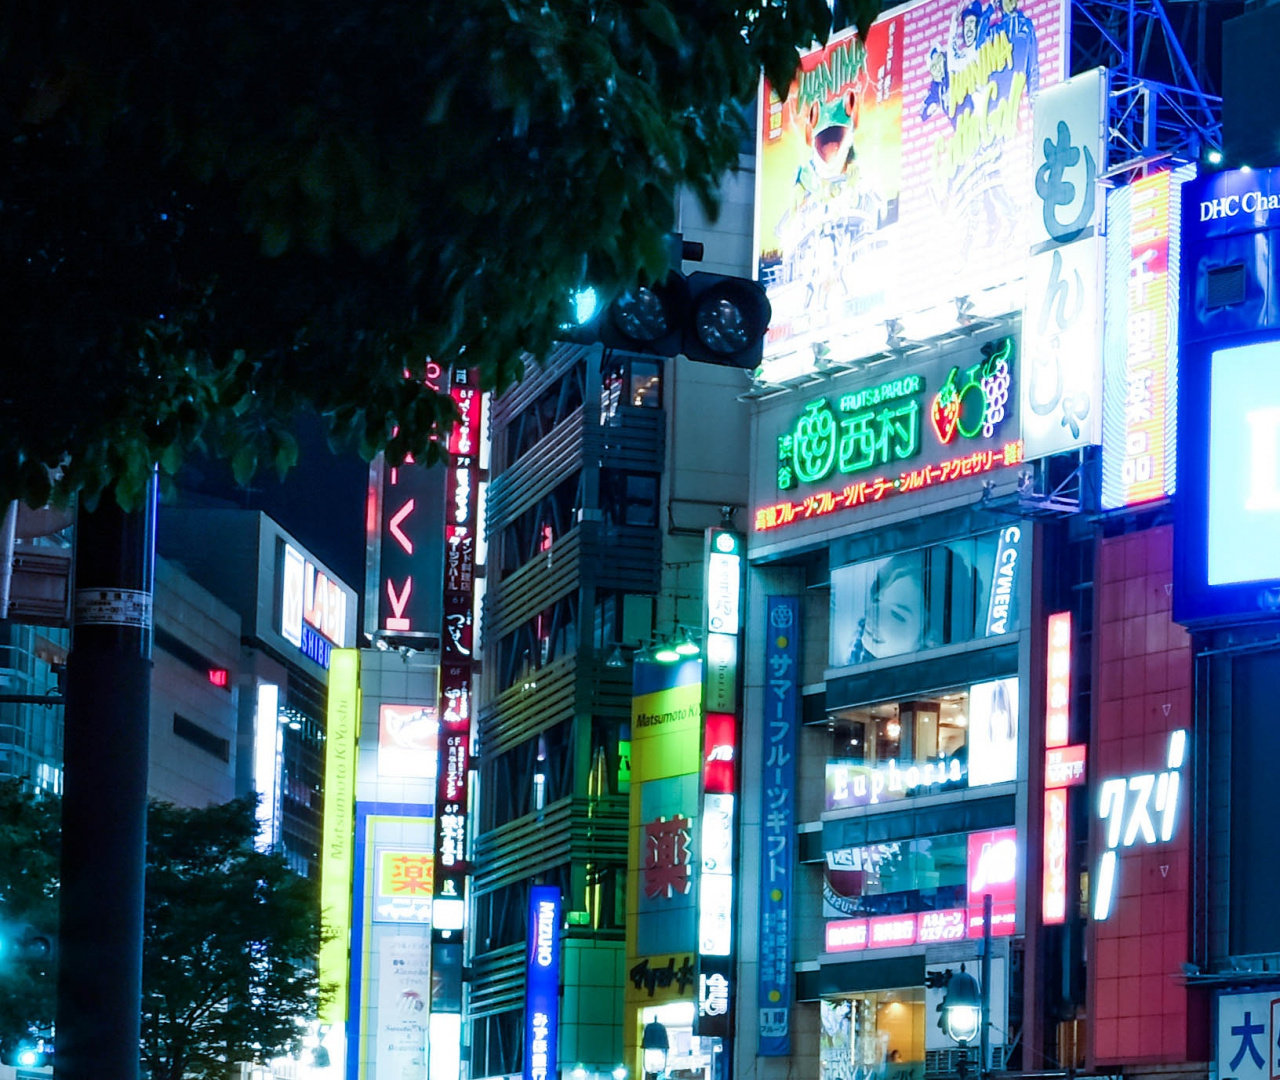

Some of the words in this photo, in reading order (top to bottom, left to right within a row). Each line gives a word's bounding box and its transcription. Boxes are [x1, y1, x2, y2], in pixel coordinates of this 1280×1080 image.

[1200, 196, 1240, 222] DHC
[1028, 121, 1095, 440] もんじゃ
[778, 435, 793, 490] 渋谷
[839, 400, 919, 472] 西村
[990, 548, 1019, 635] CAMERA
[447, 737, 461, 745] 6F
[637, 709, 687, 729] Matsumoto
[766, 653, 793, 882] サマーフルーツギフト
[833, 751, 964, 804] Euphoria
[391, 855, 434, 894] 薬
[643, 814, 692, 900] 薬
[538, 901, 554, 967] MIZUHO
